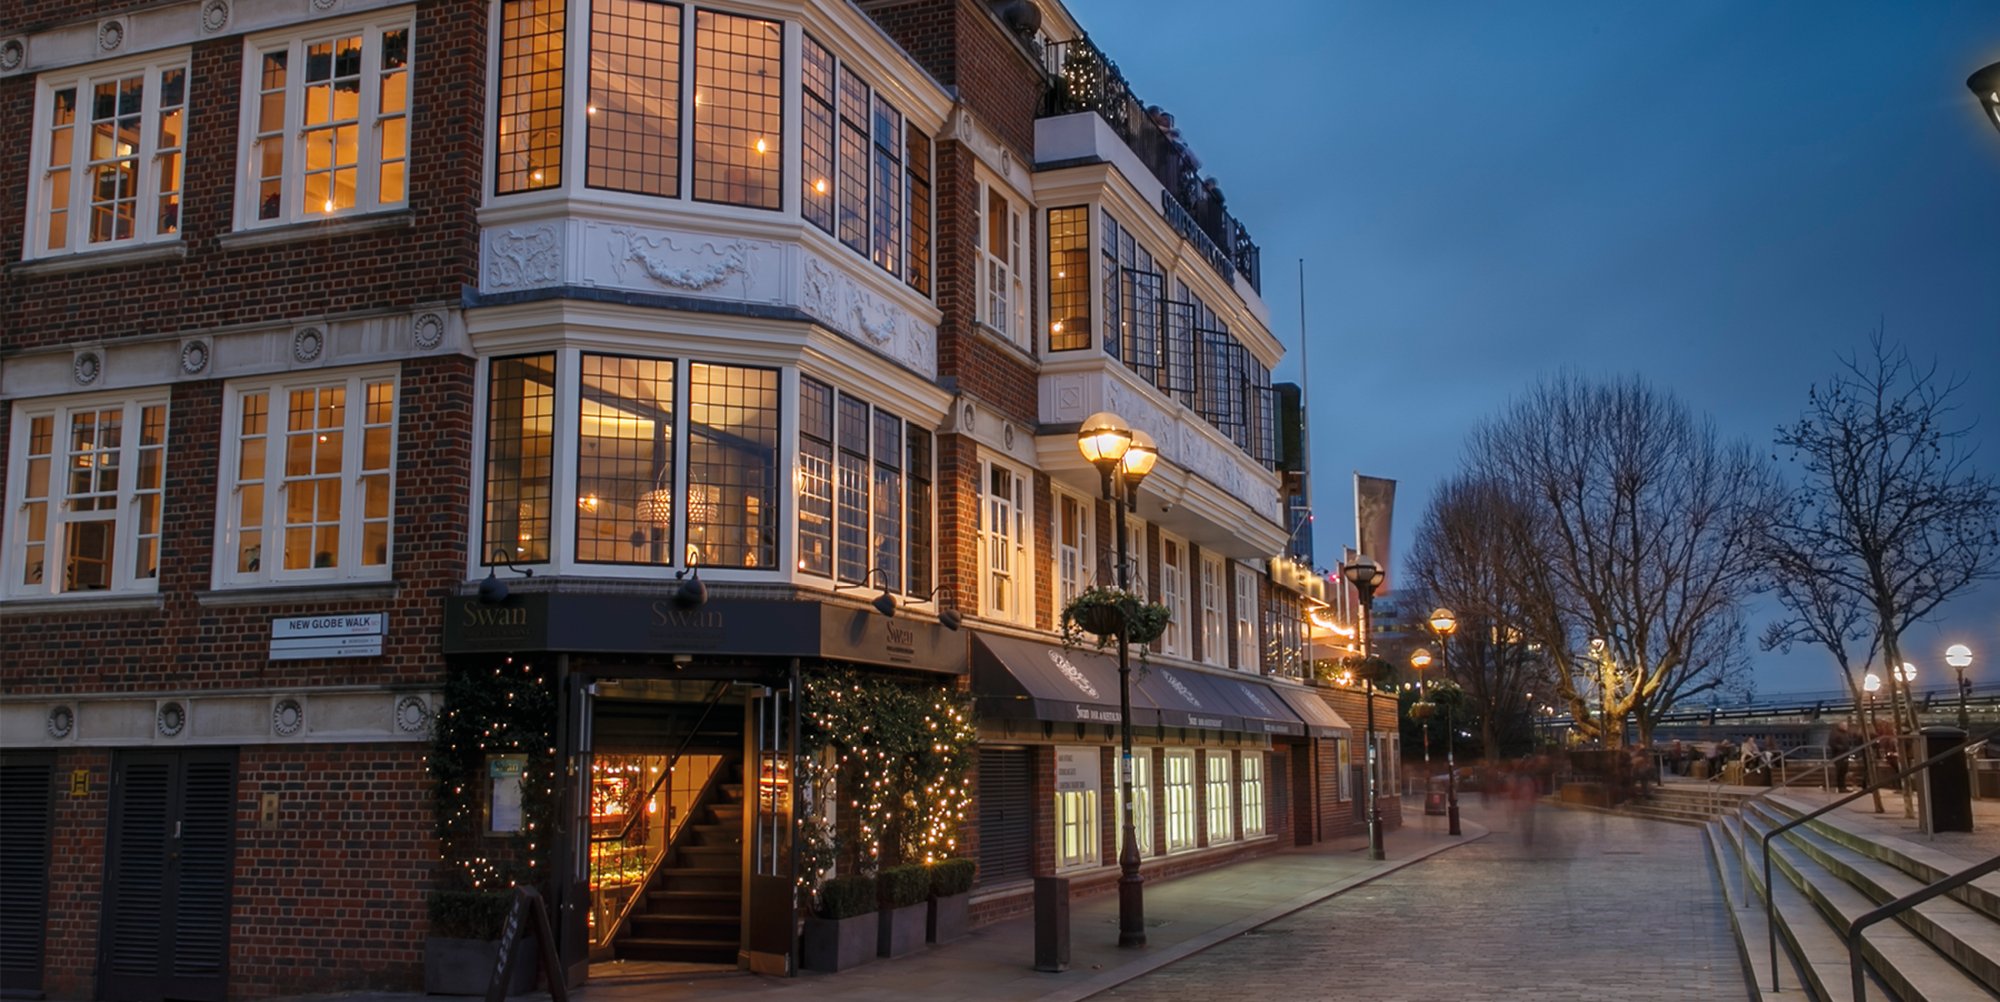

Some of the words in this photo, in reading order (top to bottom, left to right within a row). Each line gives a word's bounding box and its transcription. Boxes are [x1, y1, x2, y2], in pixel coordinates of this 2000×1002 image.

[289, 620, 310, 630] NEW
[311, 618, 344, 629] GLOBE
[345, 616, 370, 627] WALK
[463, 600, 528, 628] Swan
[651, 600, 724, 629] Swan
[886, 620, 913, 646] Swan
